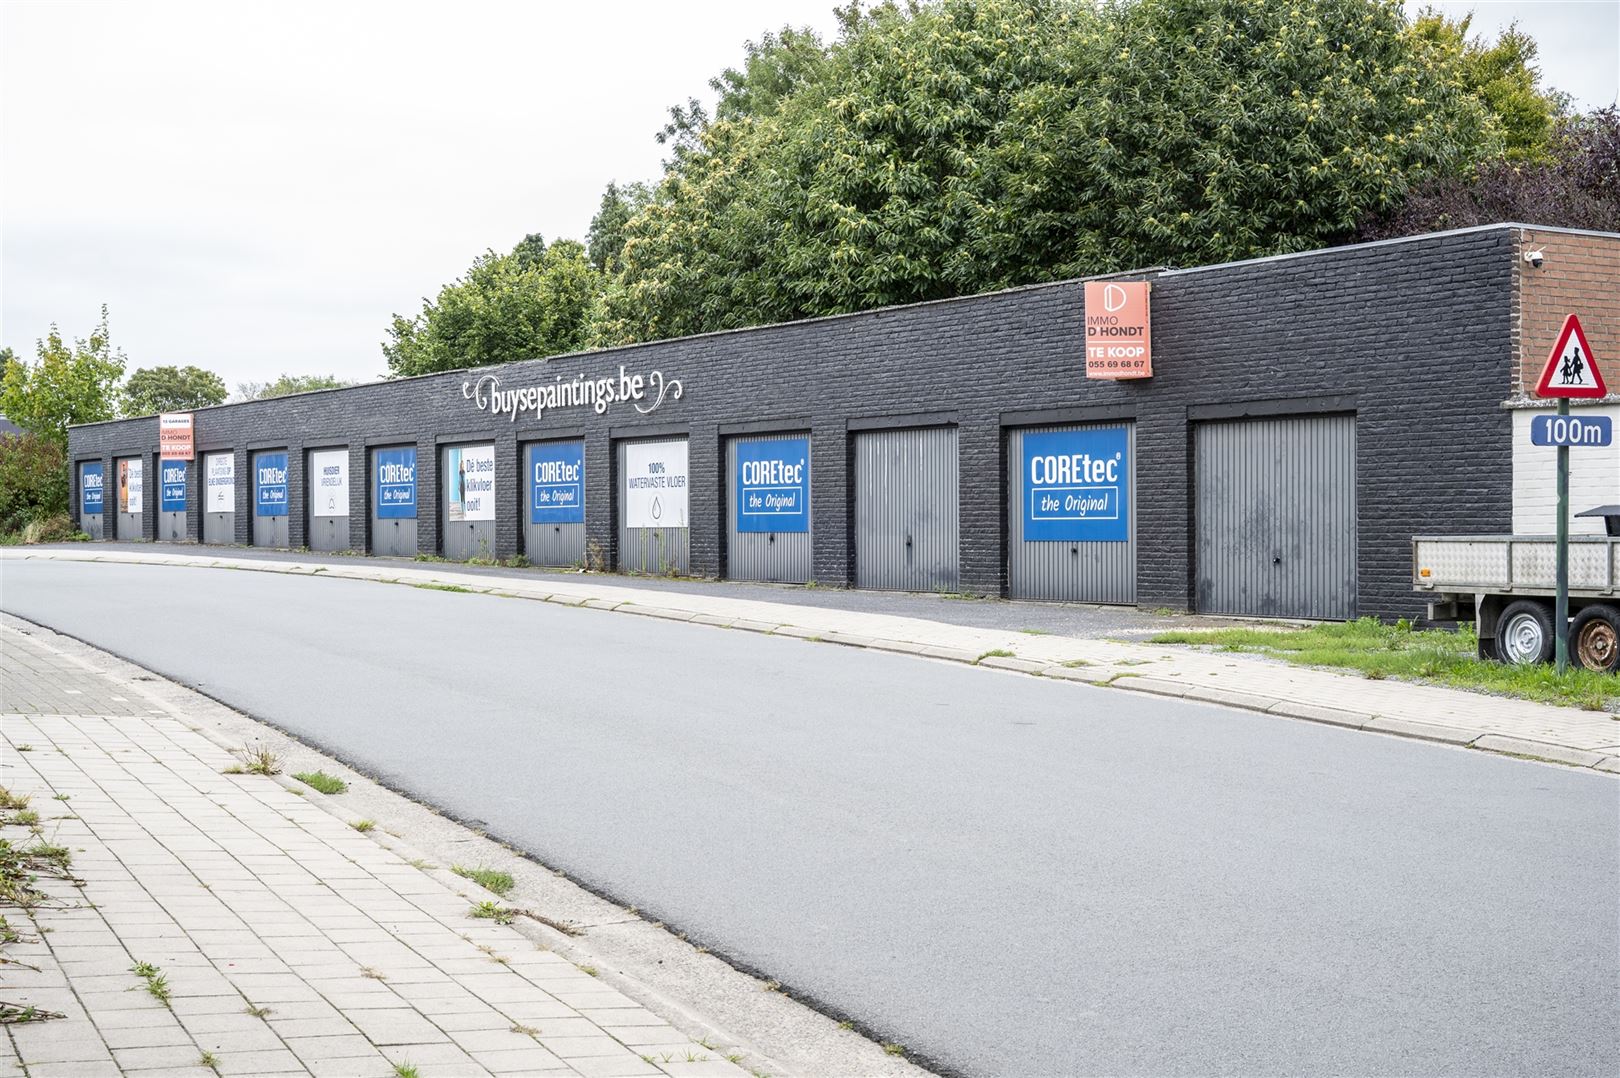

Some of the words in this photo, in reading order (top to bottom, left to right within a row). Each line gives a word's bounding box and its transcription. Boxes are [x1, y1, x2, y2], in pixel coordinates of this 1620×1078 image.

[1088, 316, 1118, 325] IMMO
[1088, 347, 1104, 357] TE
[1108, 347, 1144, 357] KOOP
[491, 366, 644, 422] buysepaintings.be
[1546, 418, 1602, 444] 100m
[476, 458, 493, 472] beste
[648, 462, 665, 474] 100%
[629, 476, 666, 489] WATERVASTE
[667, 475, 686, 488] VLOER
[393, 489, 410, 503] Original
[540, 488, 550, 502] the
[552, 487, 575, 506] Original
[749, 494, 762, 508] the
[766, 493, 795, 512] Original
[1041, 494, 1060, 511] the
[1064, 493, 1108, 516] Original
